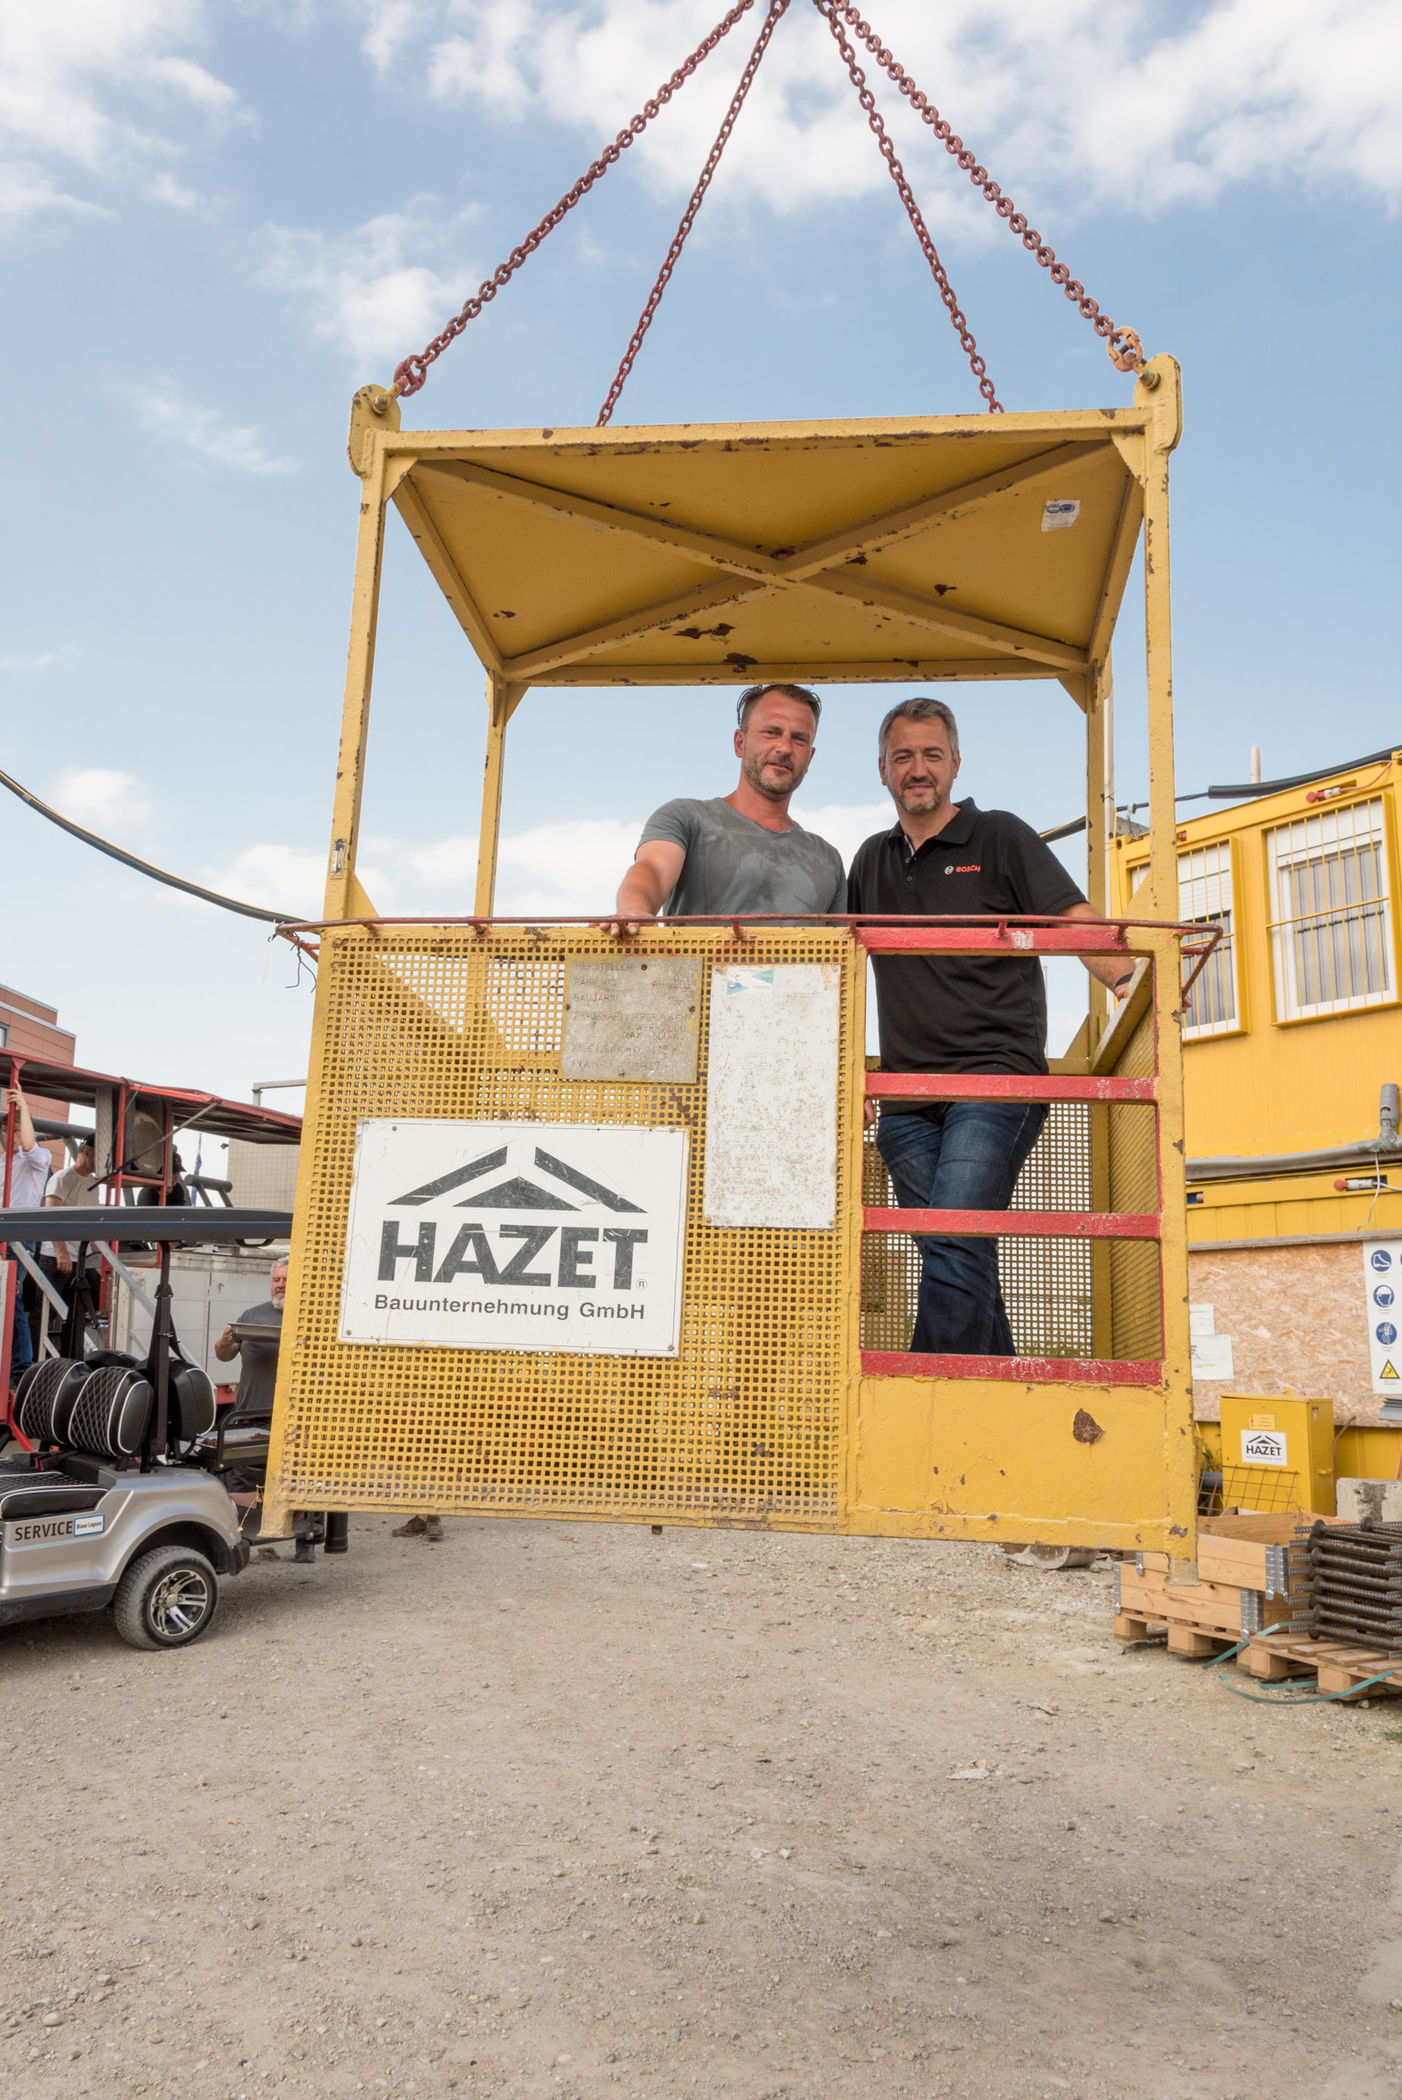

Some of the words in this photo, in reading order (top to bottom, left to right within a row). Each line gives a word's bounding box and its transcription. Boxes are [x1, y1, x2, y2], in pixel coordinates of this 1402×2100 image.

[377, 1219, 649, 1291] HAZET
[374, 1294, 570, 1321] Bauunternehmung
[579, 1301, 646, 1320] GmbH
[1246, 1445, 1282, 1456] HAZET
[15, 1521, 73, 1541] SERVICE
